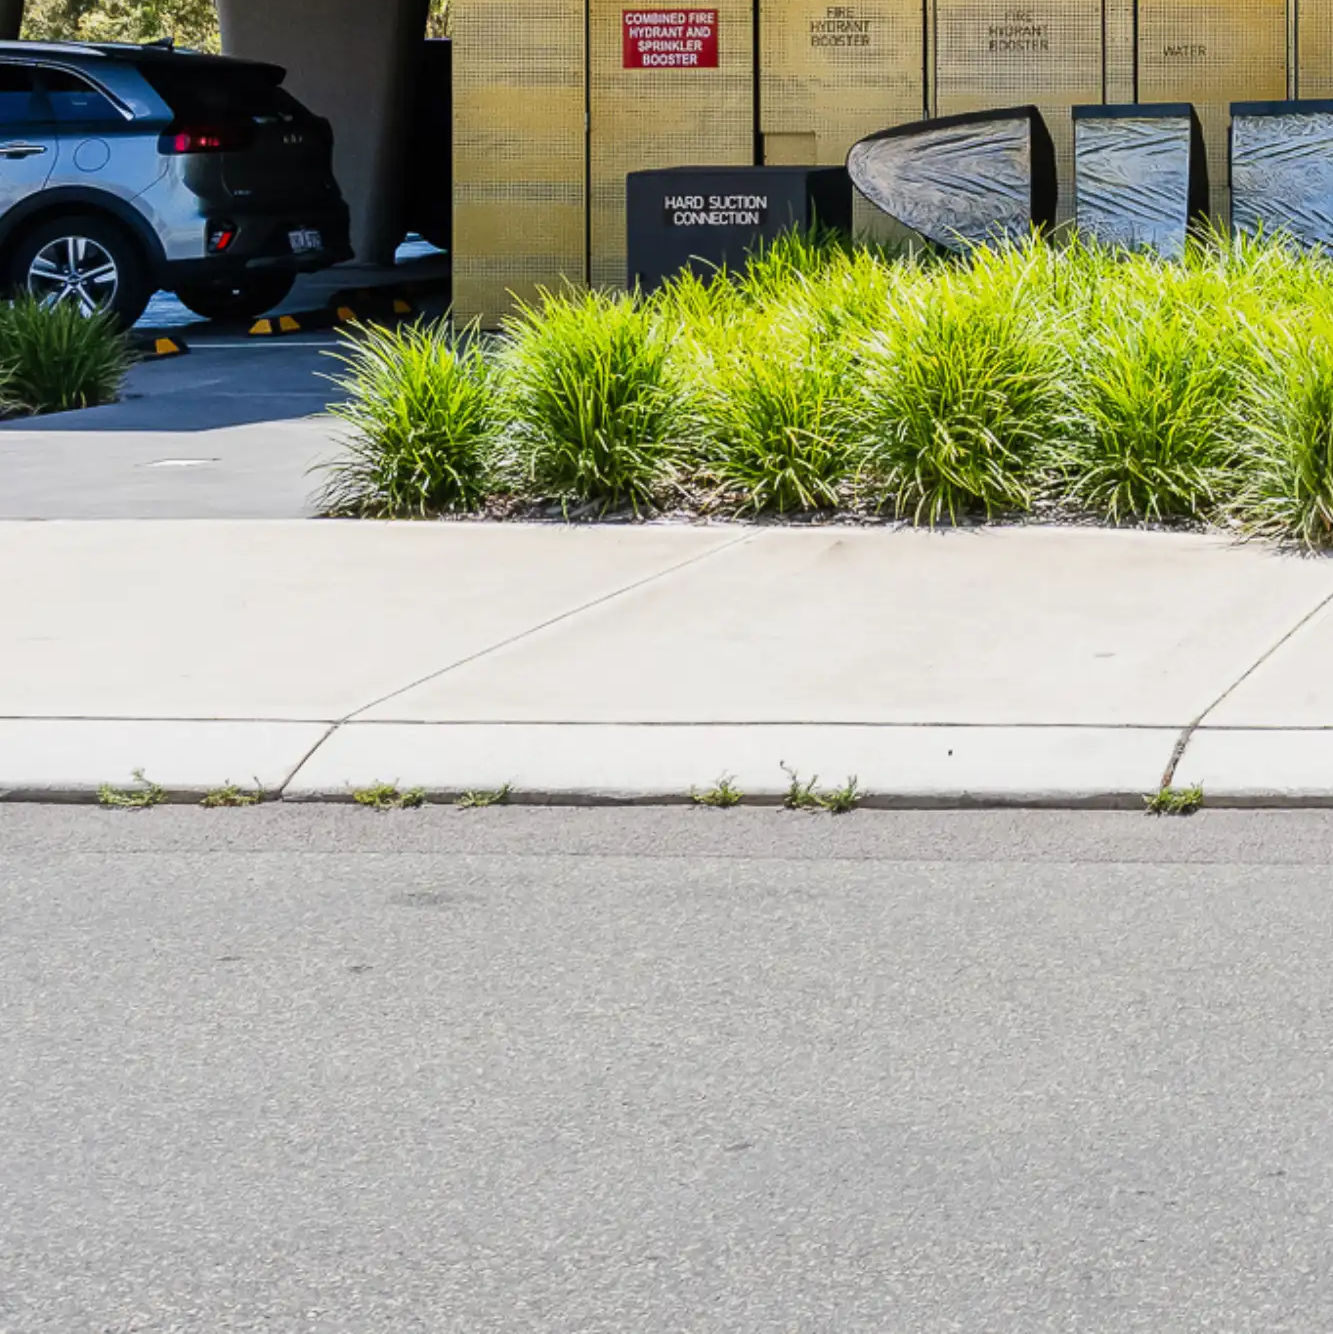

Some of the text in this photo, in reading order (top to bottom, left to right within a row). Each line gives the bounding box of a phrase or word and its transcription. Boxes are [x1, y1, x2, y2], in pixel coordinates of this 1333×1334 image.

[827, 6, 855, 18] FIRE
[625, 12, 715, 25] COMBINED FIRE
[629, 26, 711, 38] HYDRANT AND
[810, 20, 871, 32] HYDRANT
[637, 40, 703, 52] SPRINKLER
[811, 34, 871, 46] BOOSTER
[1163, 45, 1207, 57] WATER
[642, 54, 698, 65] BOOSTER
[664, 195, 768, 209] HARD SUCTION
[673, 211, 759, 225] CONNECTION
